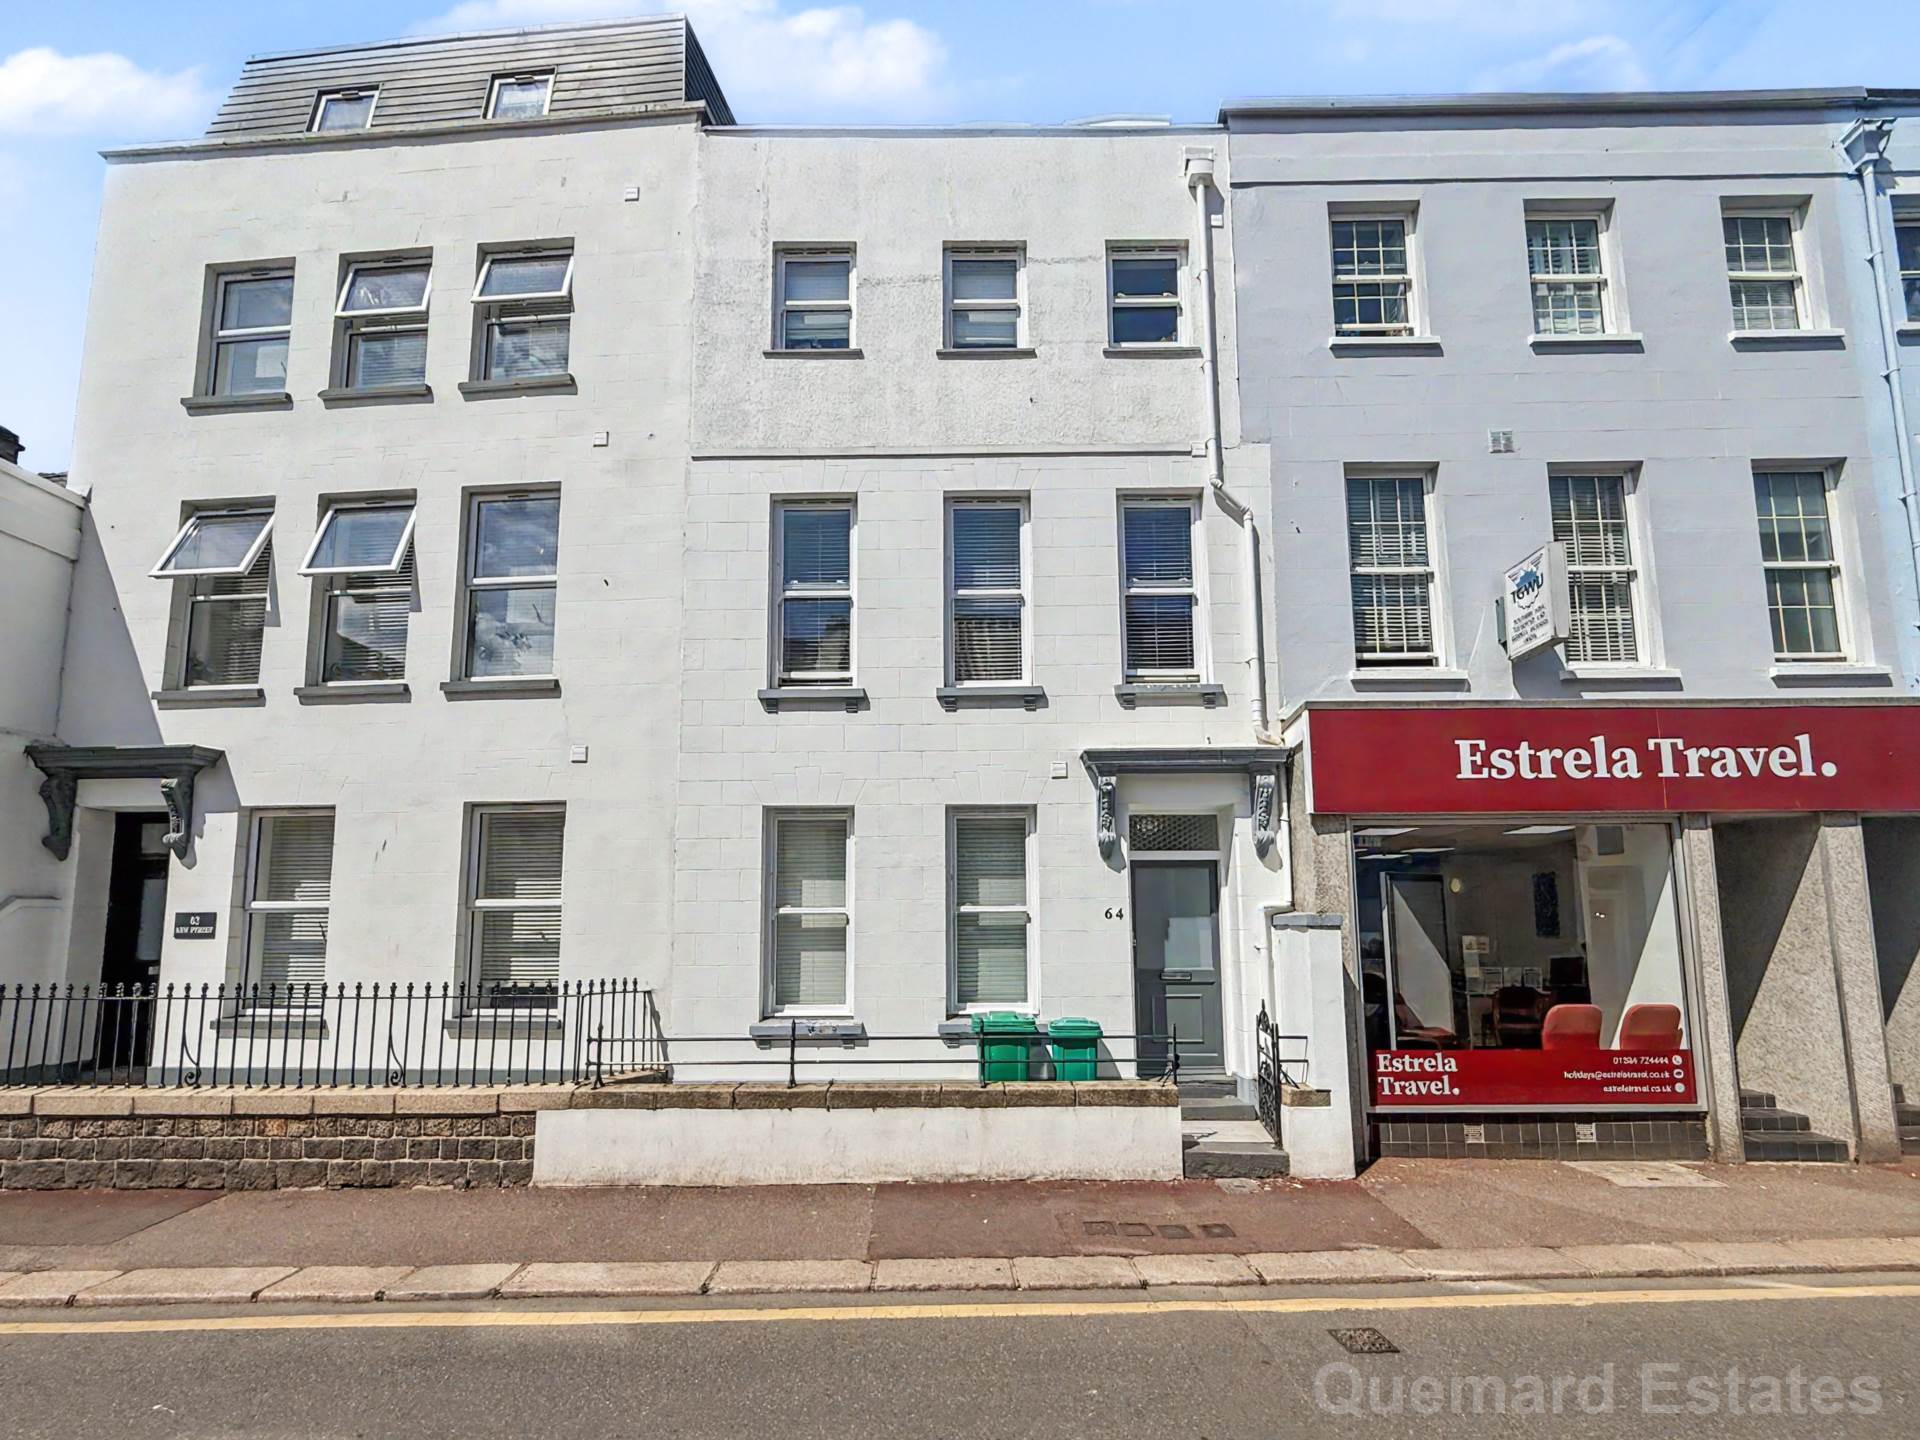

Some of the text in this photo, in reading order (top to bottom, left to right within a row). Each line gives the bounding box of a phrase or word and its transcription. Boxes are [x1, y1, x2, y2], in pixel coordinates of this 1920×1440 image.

[1511, 572, 1543, 604] TGWU
[1454, 733, 1838, 780] Estrela Travel.
[1104, 907, 1124, 921] 64
[1376, 1052, 1458, 1072] Estrela
[1377, 1074, 1460, 1095] Travel.
